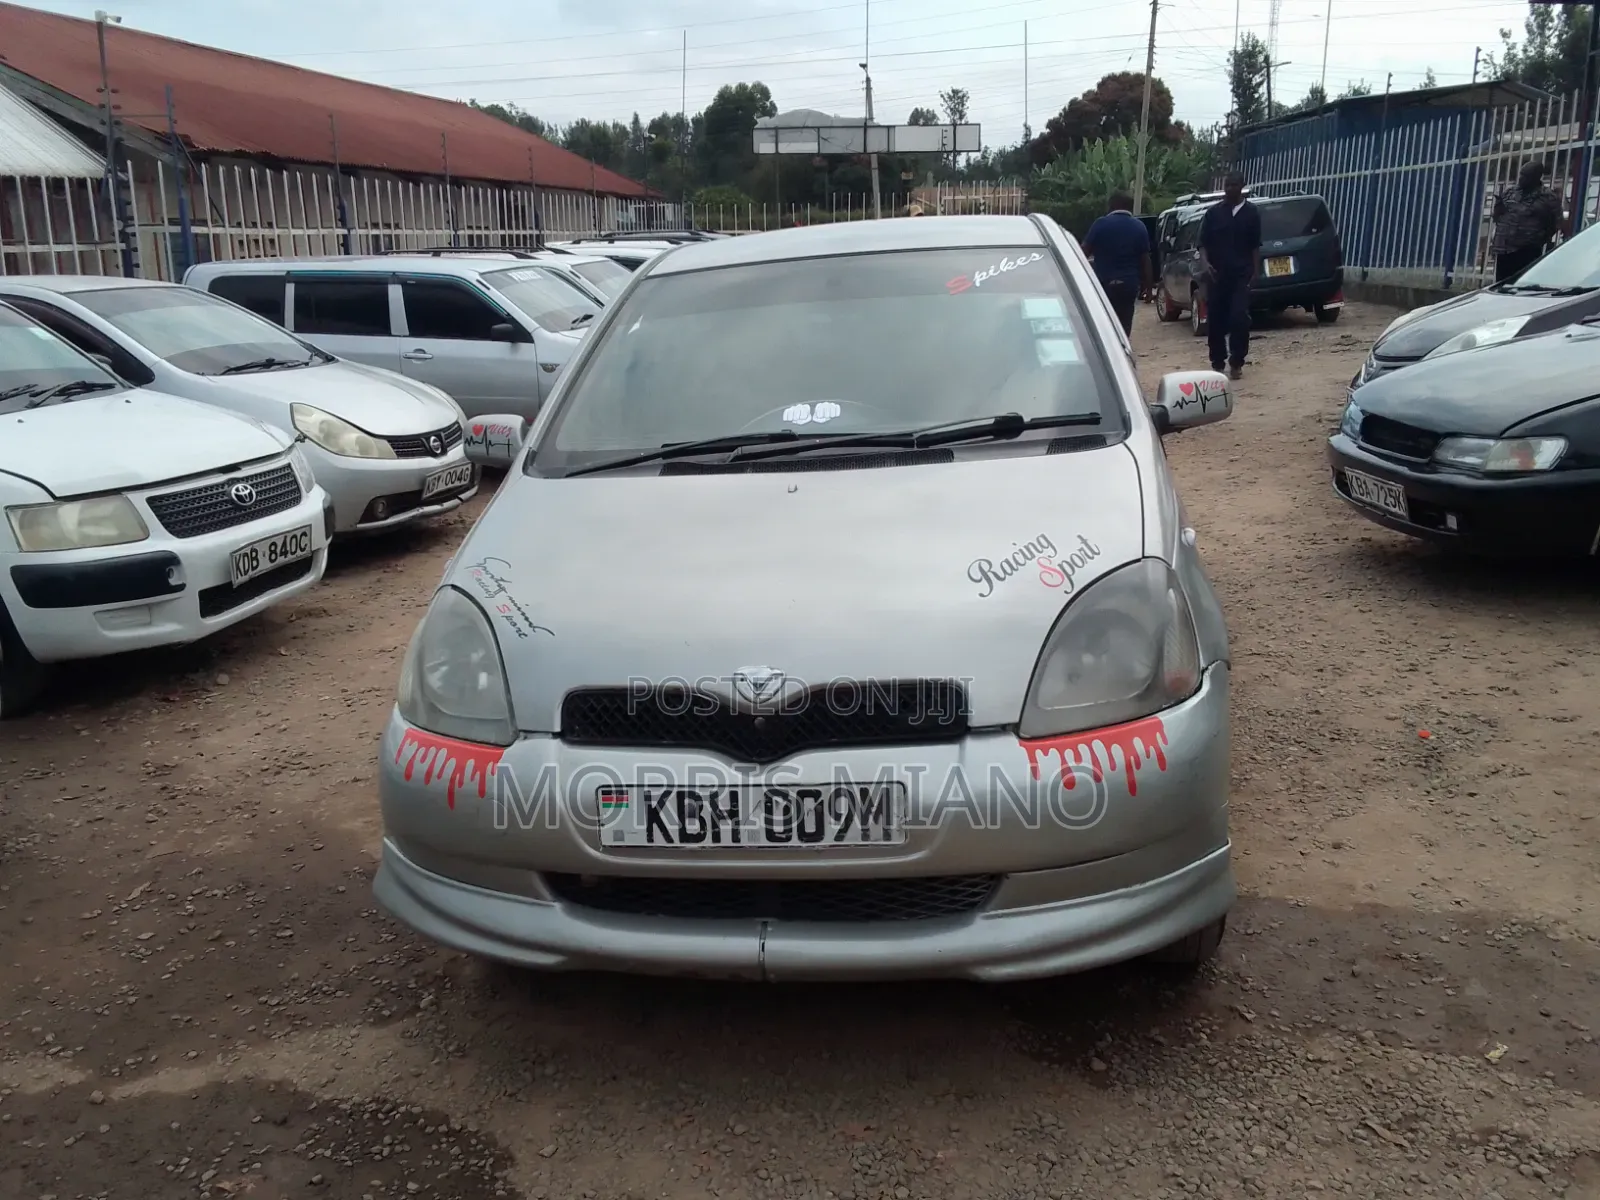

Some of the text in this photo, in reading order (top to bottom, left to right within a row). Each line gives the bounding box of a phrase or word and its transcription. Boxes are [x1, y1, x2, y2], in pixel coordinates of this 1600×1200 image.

[945, 252, 1044, 295] Spikes
[445, 467, 470, 487] 004G
[1346, 472, 1406, 512] KBA 725K
[234, 531, 308, 580] KDB 840C
[967, 533, 1058, 598] Racing
[1037, 534, 1101, 595] Sport
[495, 603, 529, 640] Sport
[644, 790, 741, 844] KBH
